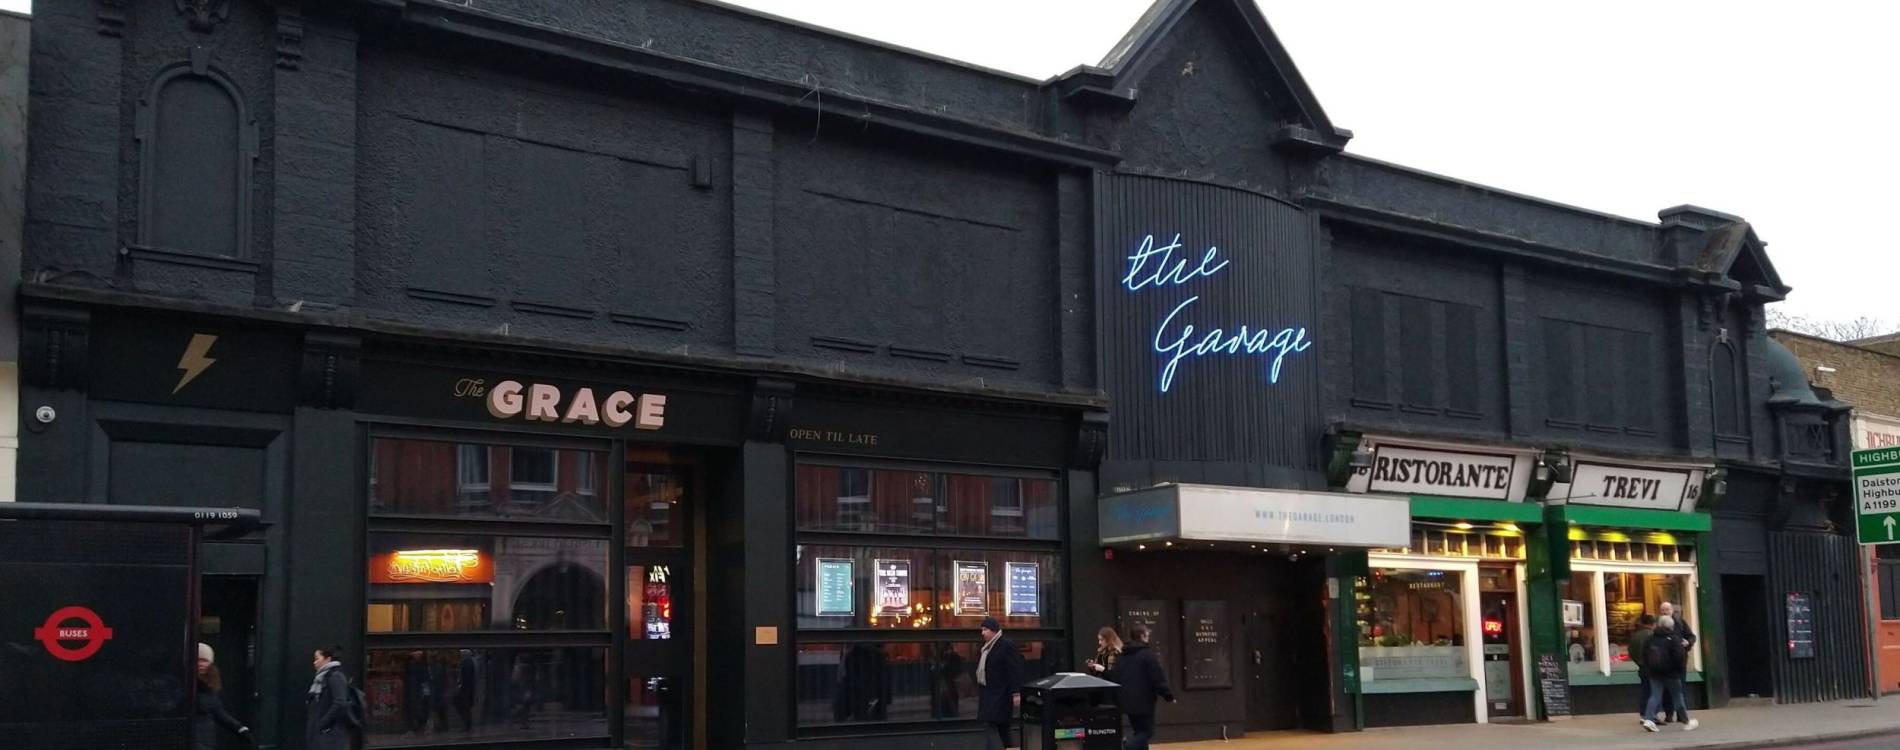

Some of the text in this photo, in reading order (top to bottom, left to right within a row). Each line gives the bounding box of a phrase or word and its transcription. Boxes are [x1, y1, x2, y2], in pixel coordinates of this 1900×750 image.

[1154, 294, 1312, 393] Garage
[454, 378, 667, 430] The GRACE
[789, 428, 878, 445] OPEN TIL LATE
[1859, 450, 1900, 463] HIGHB
[1374, 456, 1509, 489] RISTORANTE
[1602, 475, 1661, 500] TREVI
[1686, 484, 1699, 499] 16
[194, 511, 238, 519] 0119 1059
[59, 629, 88, 638] BUSES
